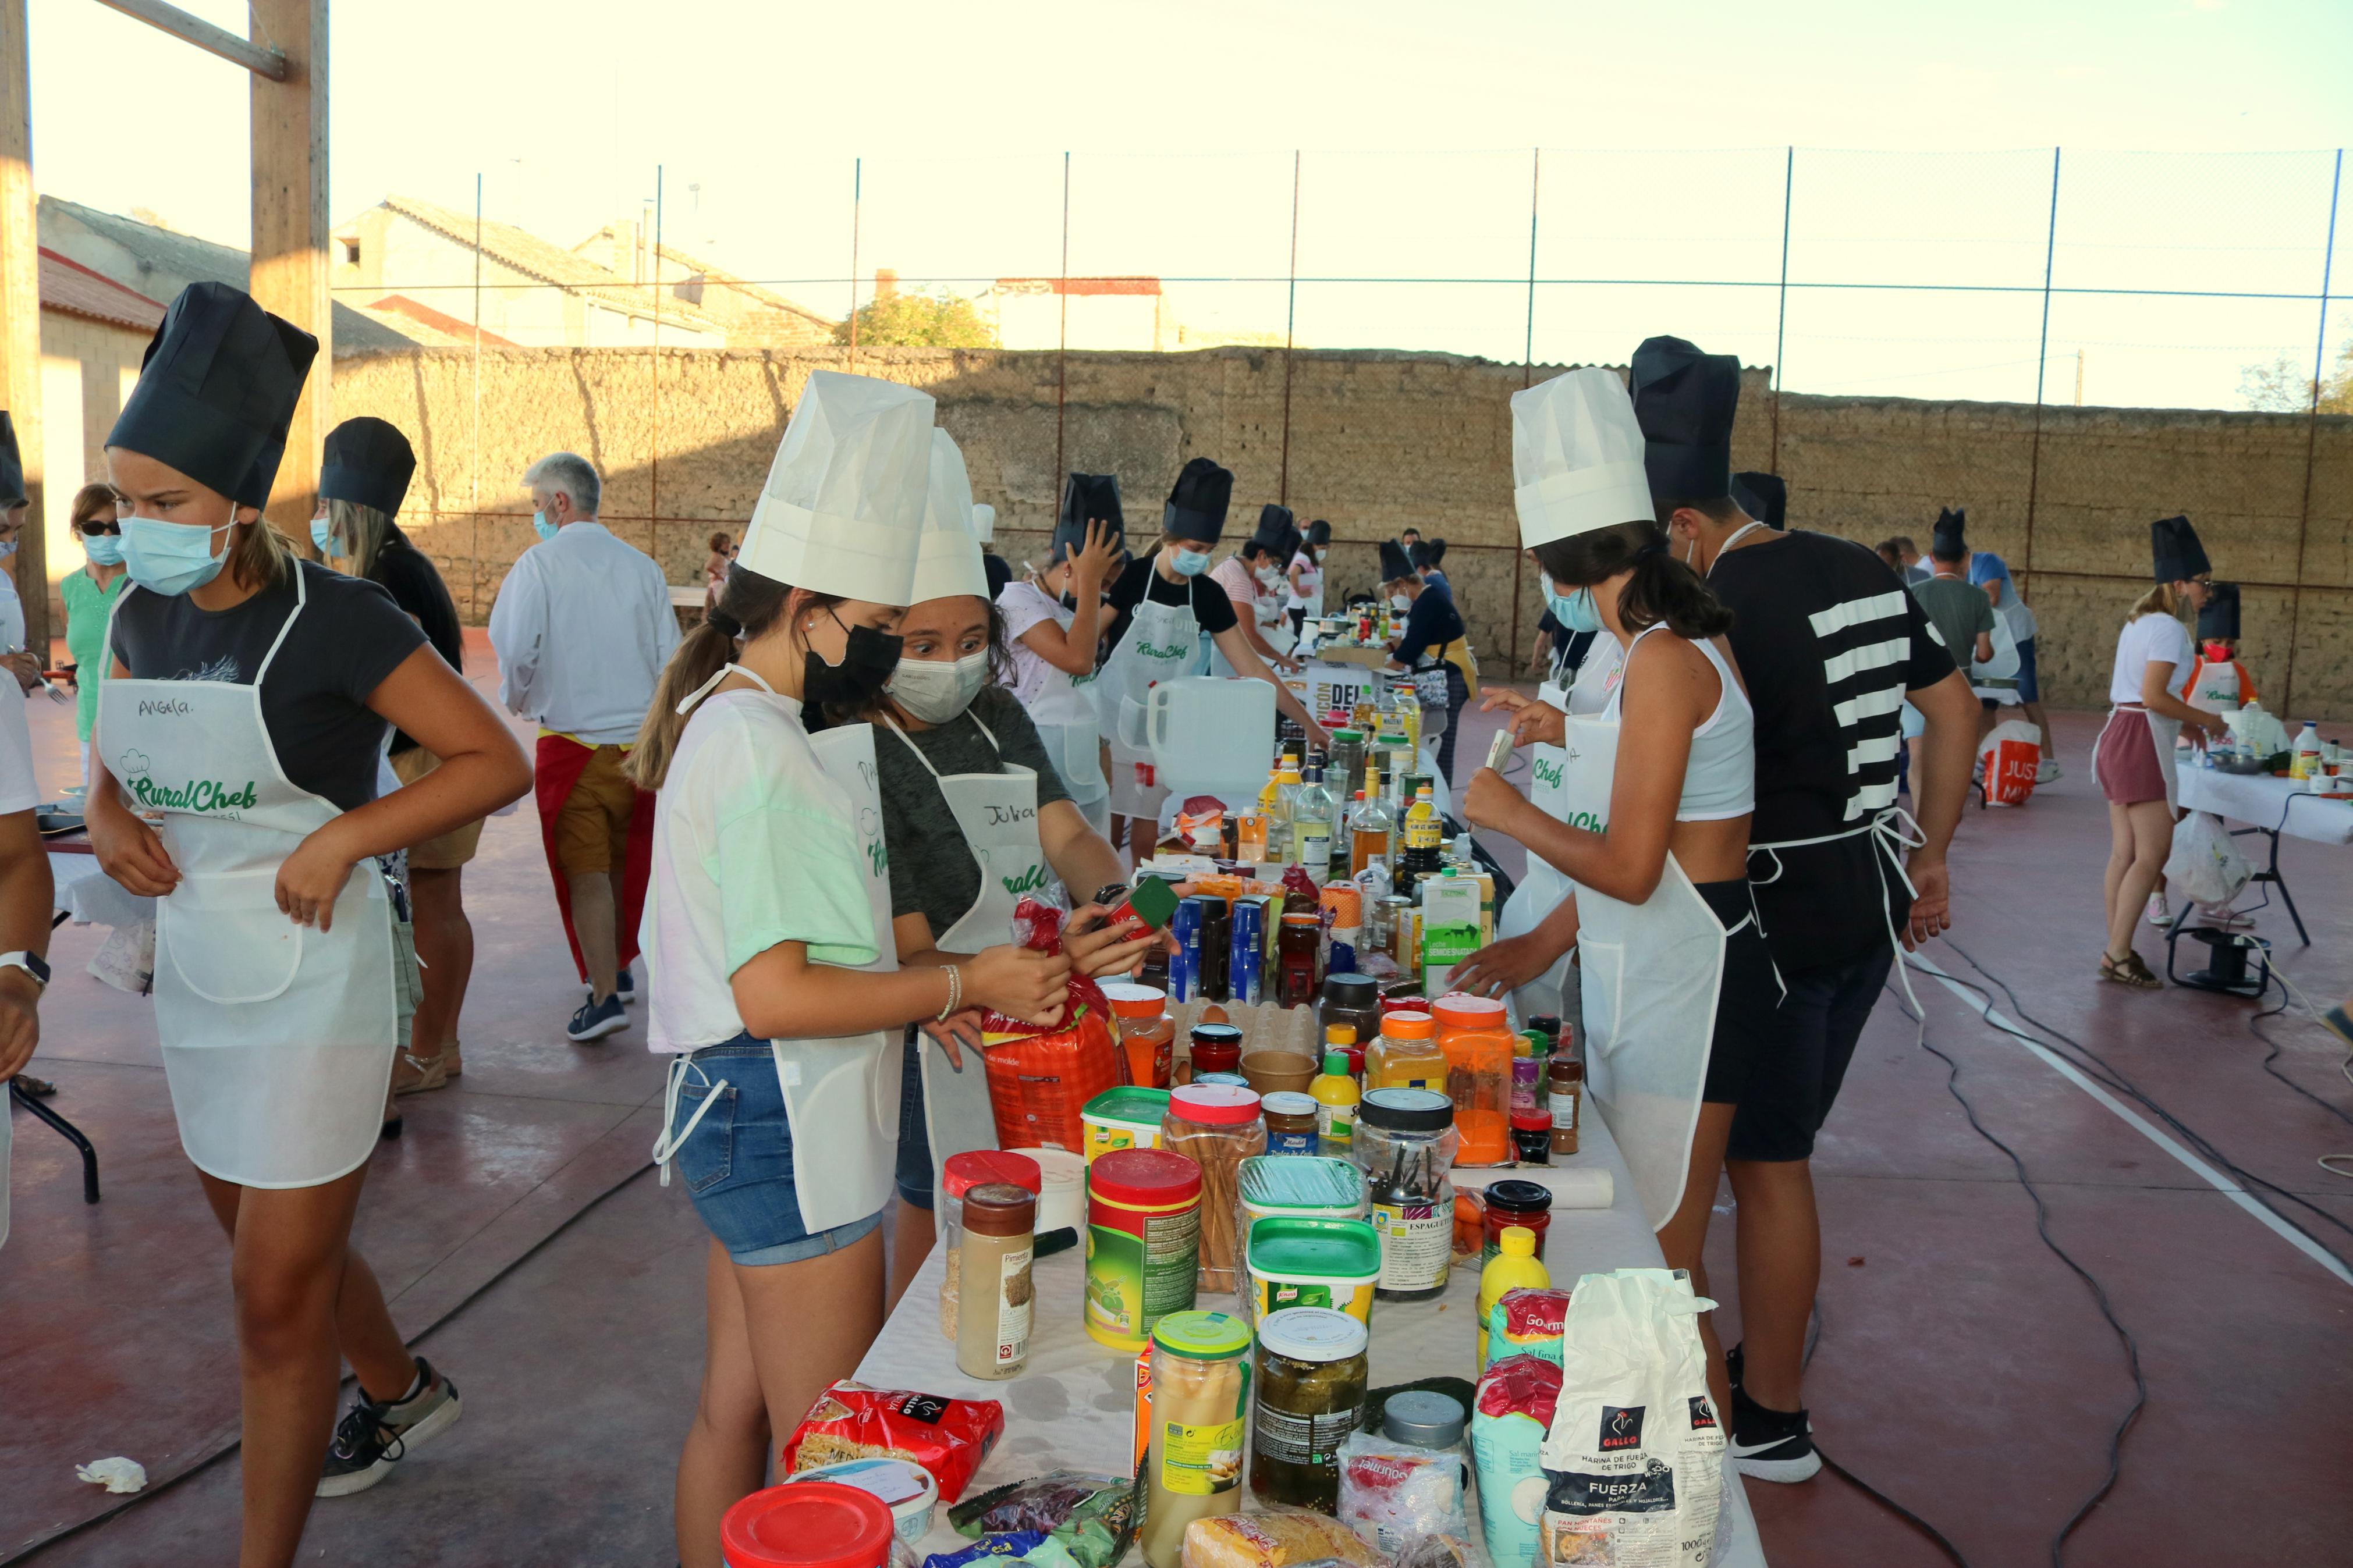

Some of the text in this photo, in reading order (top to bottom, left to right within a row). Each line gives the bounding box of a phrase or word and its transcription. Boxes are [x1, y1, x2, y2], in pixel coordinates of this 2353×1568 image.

[127, 777, 257, 812] RuralChef
[984, 805, 1035, 826] Julia
[1428, 947, 1478, 957] SEMIDESNATADA
[987, 1054, 1020, 1066] de molde
[1005, 1251, 1029, 1263] Pimienta
[1538, 1349, 1556, 1360] fina
[1603, 1436, 1637, 1448] GALLO
[1509, 1449, 1519, 1457] Sal
[1582, 1456, 1611, 1464] HARINA
[1626, 1452, 1648, 1462] FUERZA
[1358, 1459, 1408, 1484] Gourmet
[1614, 1462, 1637, 1470] TRIGO
[1589, 1482, 1647, 1495] FUERZA
[1561, 1499, 1587, 1508] BOLLERÍA,
